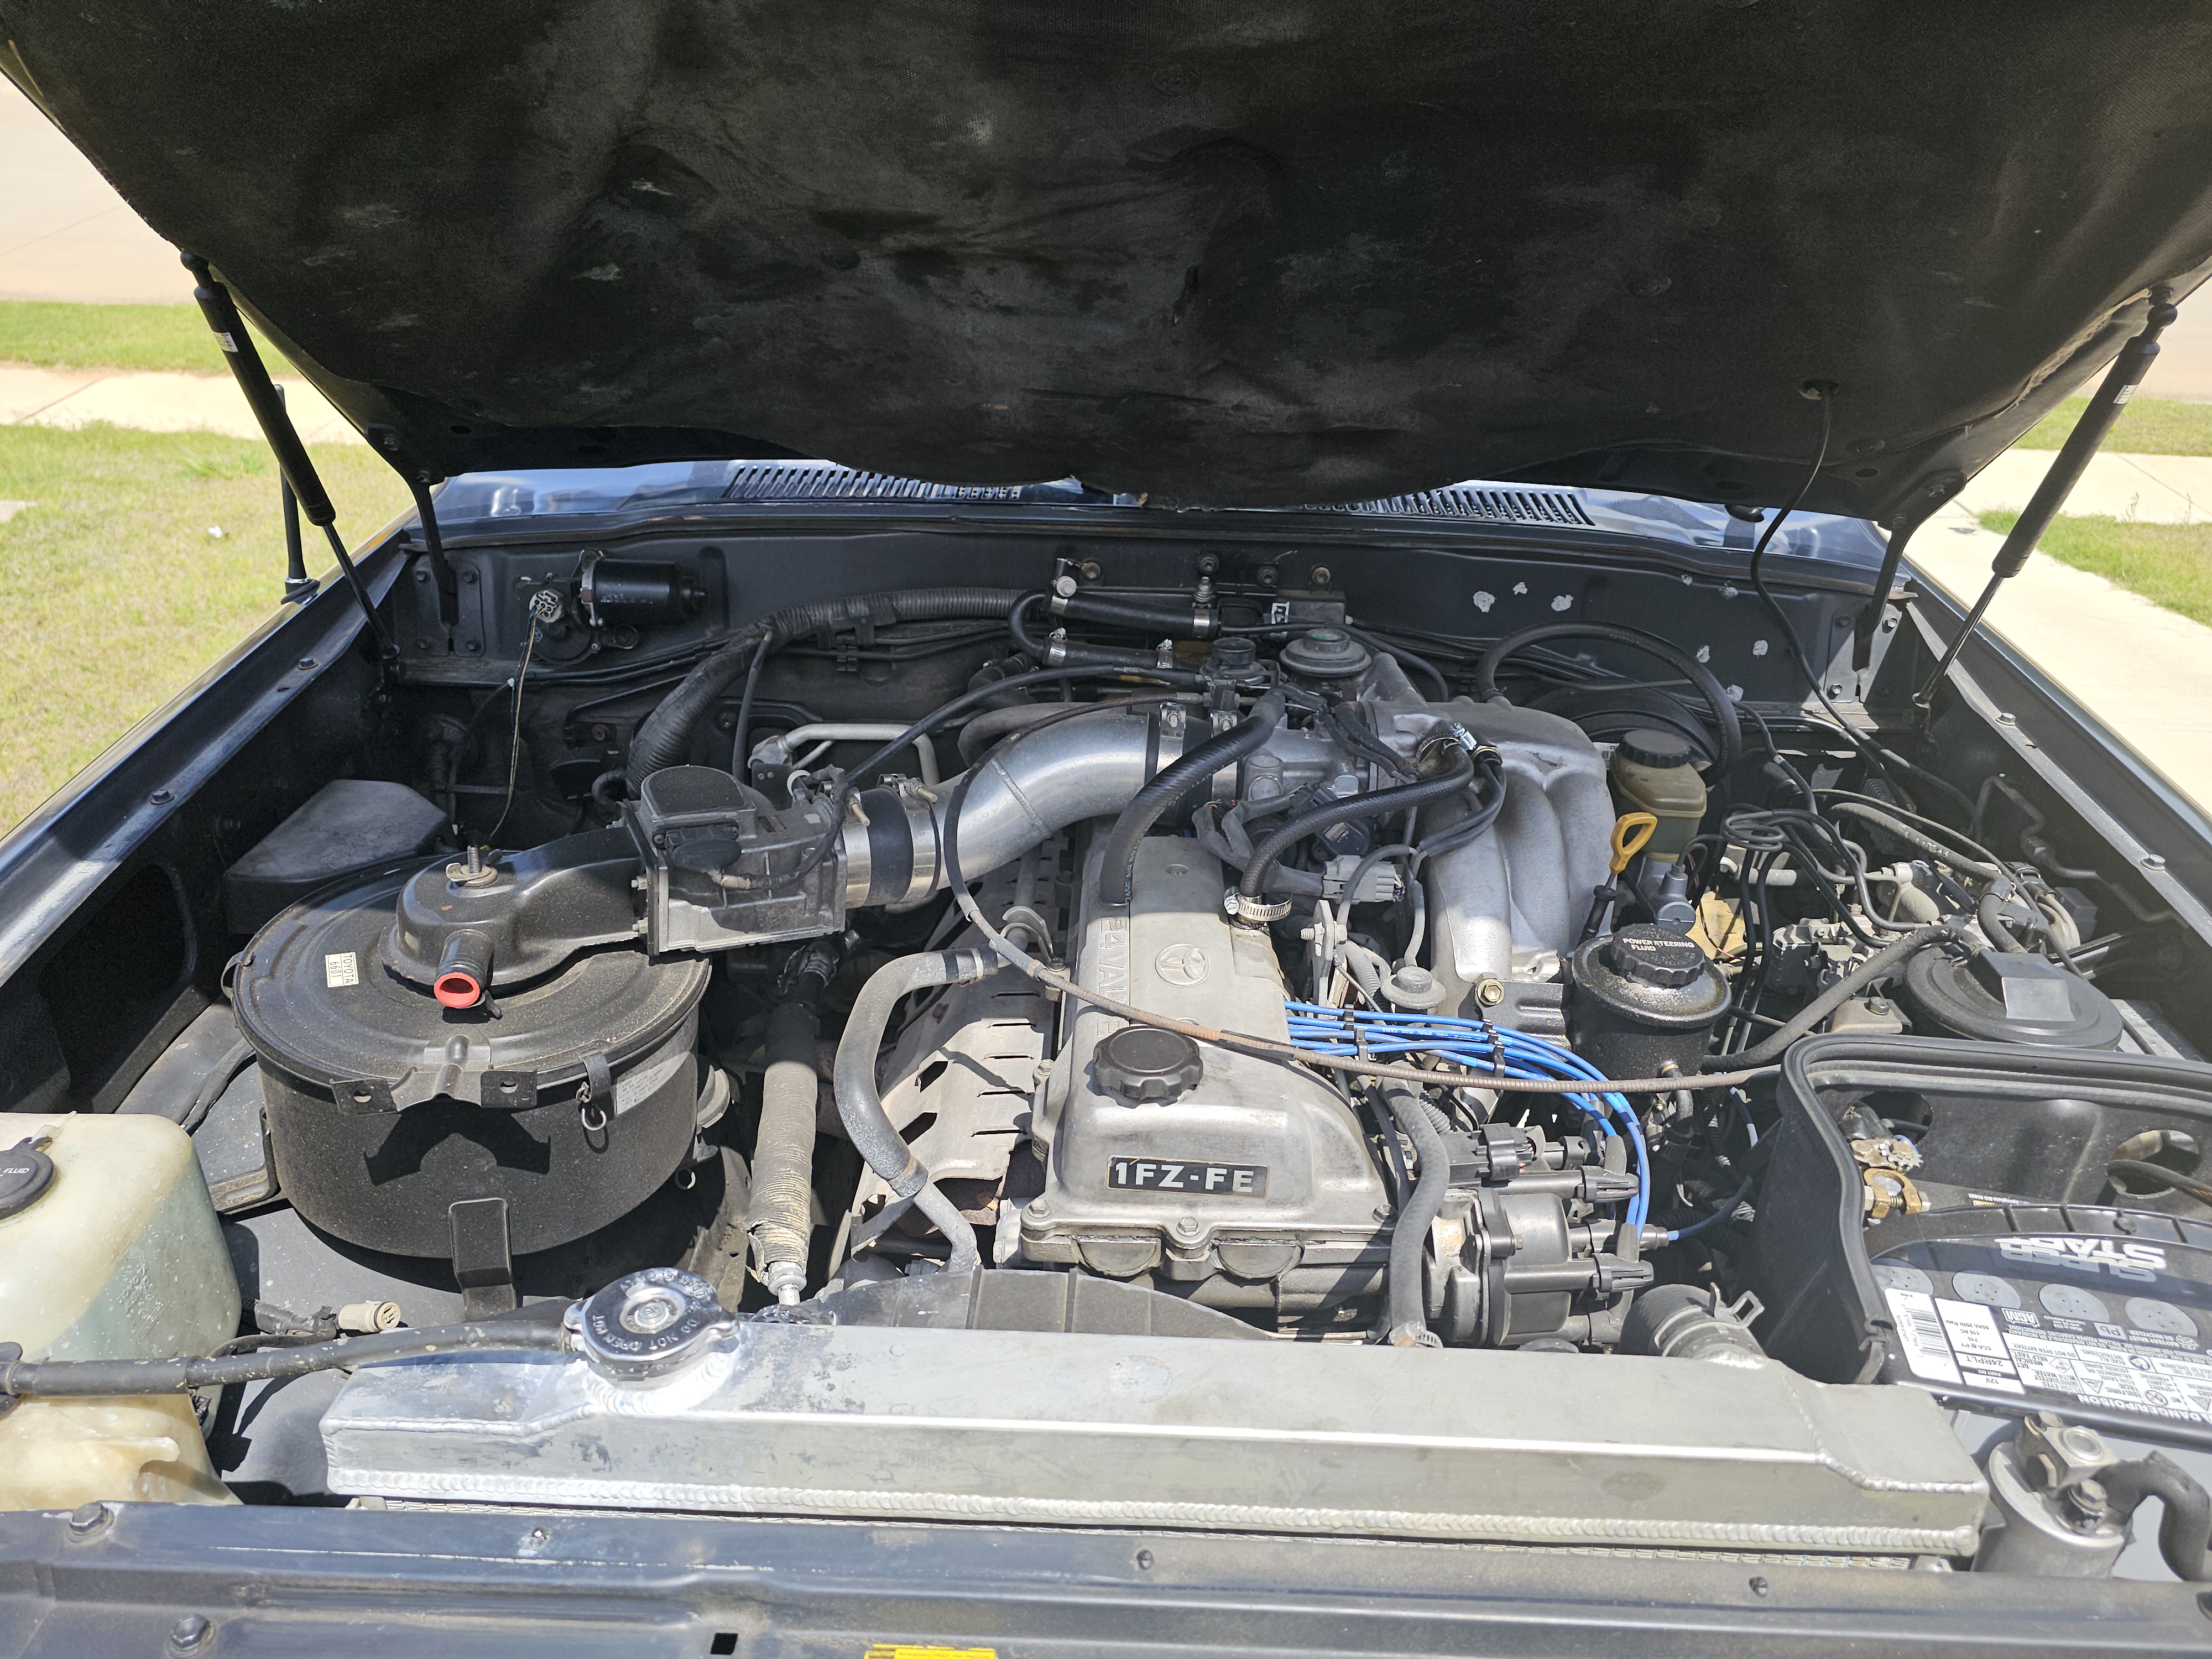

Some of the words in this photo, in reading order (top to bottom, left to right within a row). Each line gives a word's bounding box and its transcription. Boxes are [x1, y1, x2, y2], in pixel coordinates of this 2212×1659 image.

[1100, 917, 1127, 948] 24
[1653, 940, 1695, 948] STEERING
[330, 962, 342, 977] 6601
[343, 954, 354, 984] TOYOTA
[1097, 952, 1127, 1036] VALE
[1115, 1162, 1254, 1193] 1FZ-FE
[1999, 1242, 2156, 1282] SUPER
[2004, 1310, 2036, 1323] AGM
[592, 1314, 609, 1335] HOT
[681, 1319, 697, 1333] DO
[2100, 1326, 2121, 1337] Pb
[602, 1333, 643, 1353] OPEN
[649, 1332, 679, 1350] NOT
[2128, 1334, 2149, 1343] MUST
[2012, 1343, 2037, 1353] BATTERY.
[2011, 1350, 2030, 1359] FAST.
[2079, 1348, 2123, 1360] INSTRUCTIONS.
[1966, 1355, 2004, 1367] 24RPLT
[2013, 1356, 2044, 1366] MEDICAL
[2110, 1358, 2126, 1366] READ
[2031, 1368, 2057, 1379] WATER.
[2095, 1368, 2128, 1379] BLINDNESS
[2103, 1365, 2126, 1374] SEVERE
[2034, 1375, 2078, 1387] IMMEDIATELY
[2059, 1373, 2077, 1382] WITH
[2099, 1374, 2119, 1383] CAUSE
[2042, 1381, 2059, 1390] EYES
[2118, 1383, 2134, 1391] ACID
[2104, 1386, 2136, 1397] SULFURIC
[2077, 1394, 2202, 1423] DANGER/POISON
